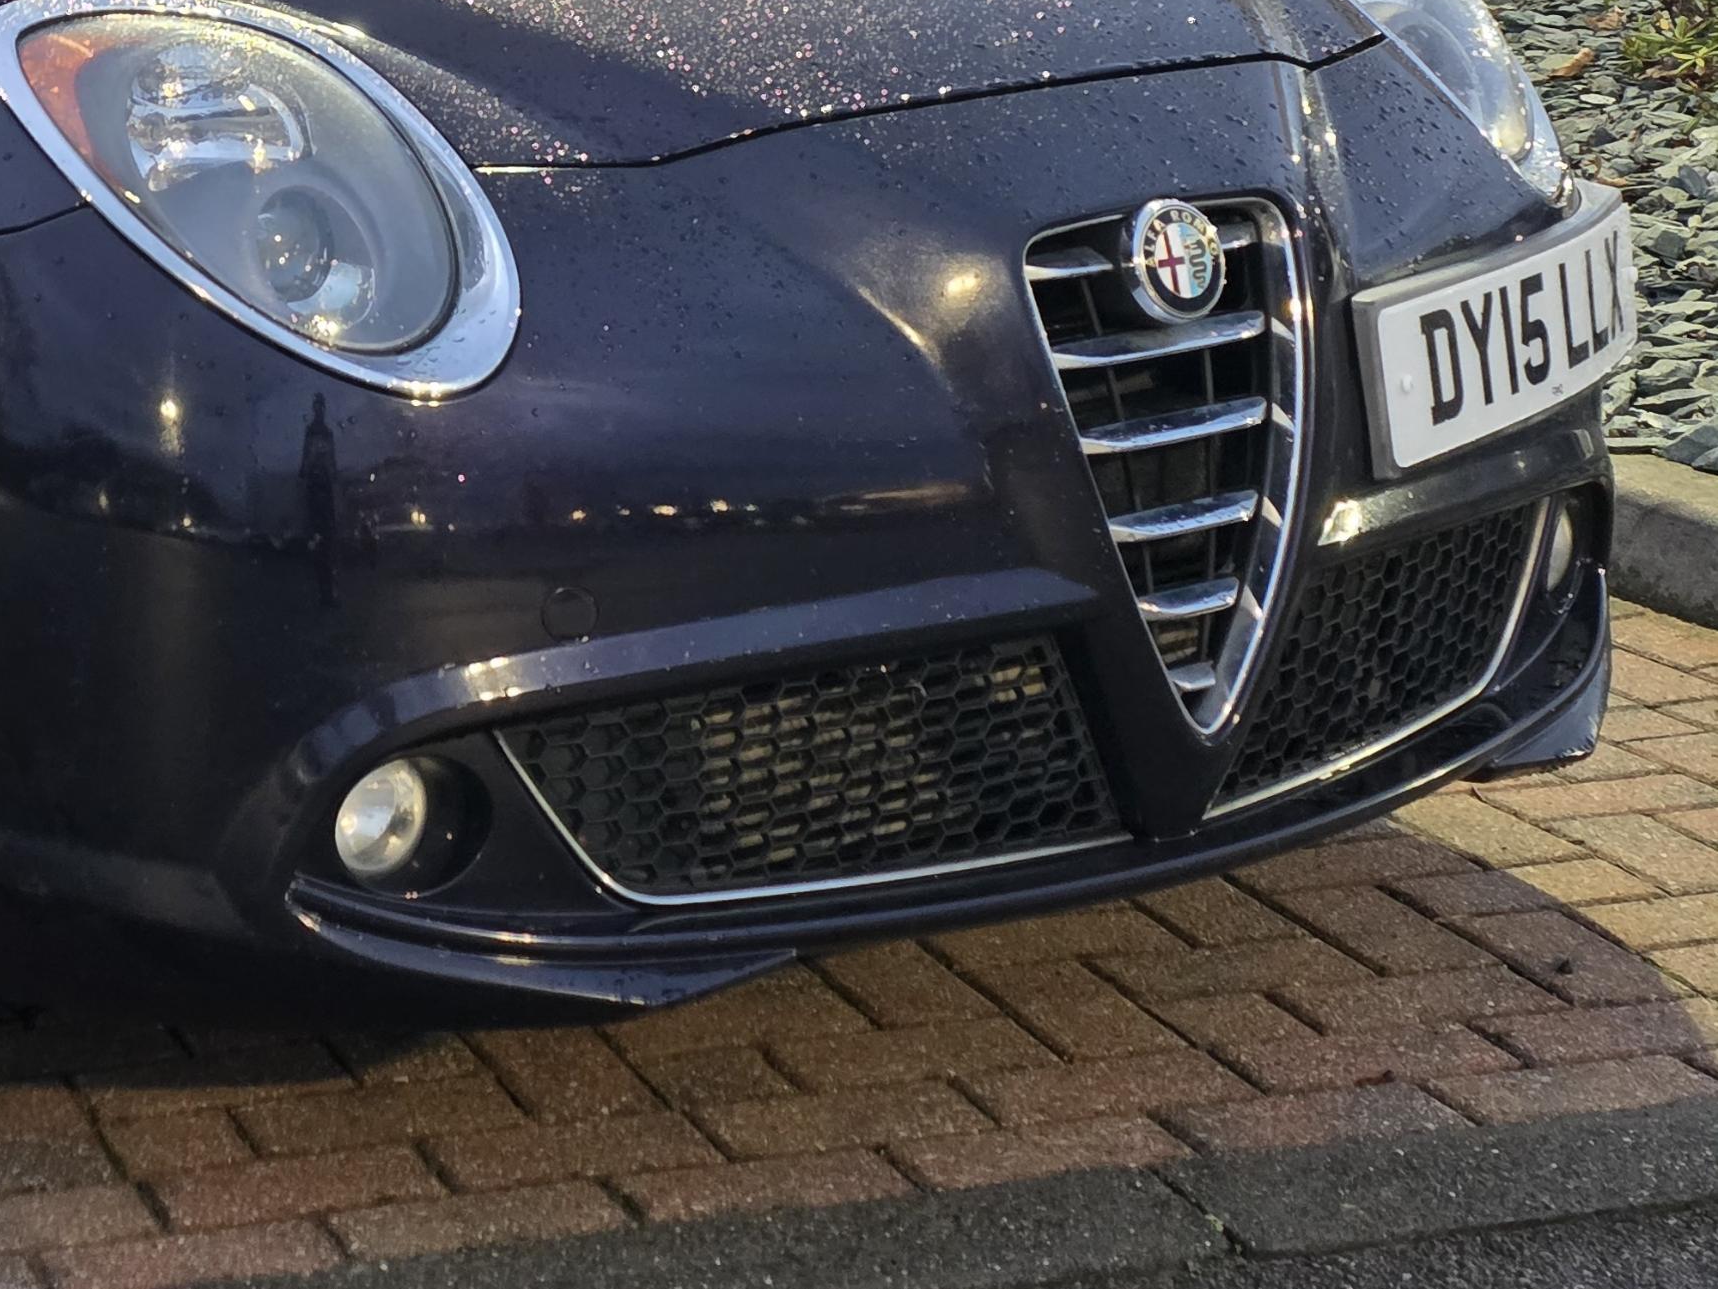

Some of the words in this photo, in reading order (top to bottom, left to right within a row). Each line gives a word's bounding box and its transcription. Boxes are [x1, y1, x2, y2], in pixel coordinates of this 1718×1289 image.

[1144, 219, 1166, 268] ALFA
[1419, 272, 1551, 426] DY15
[1558, 230, 1624, 369] LLX
